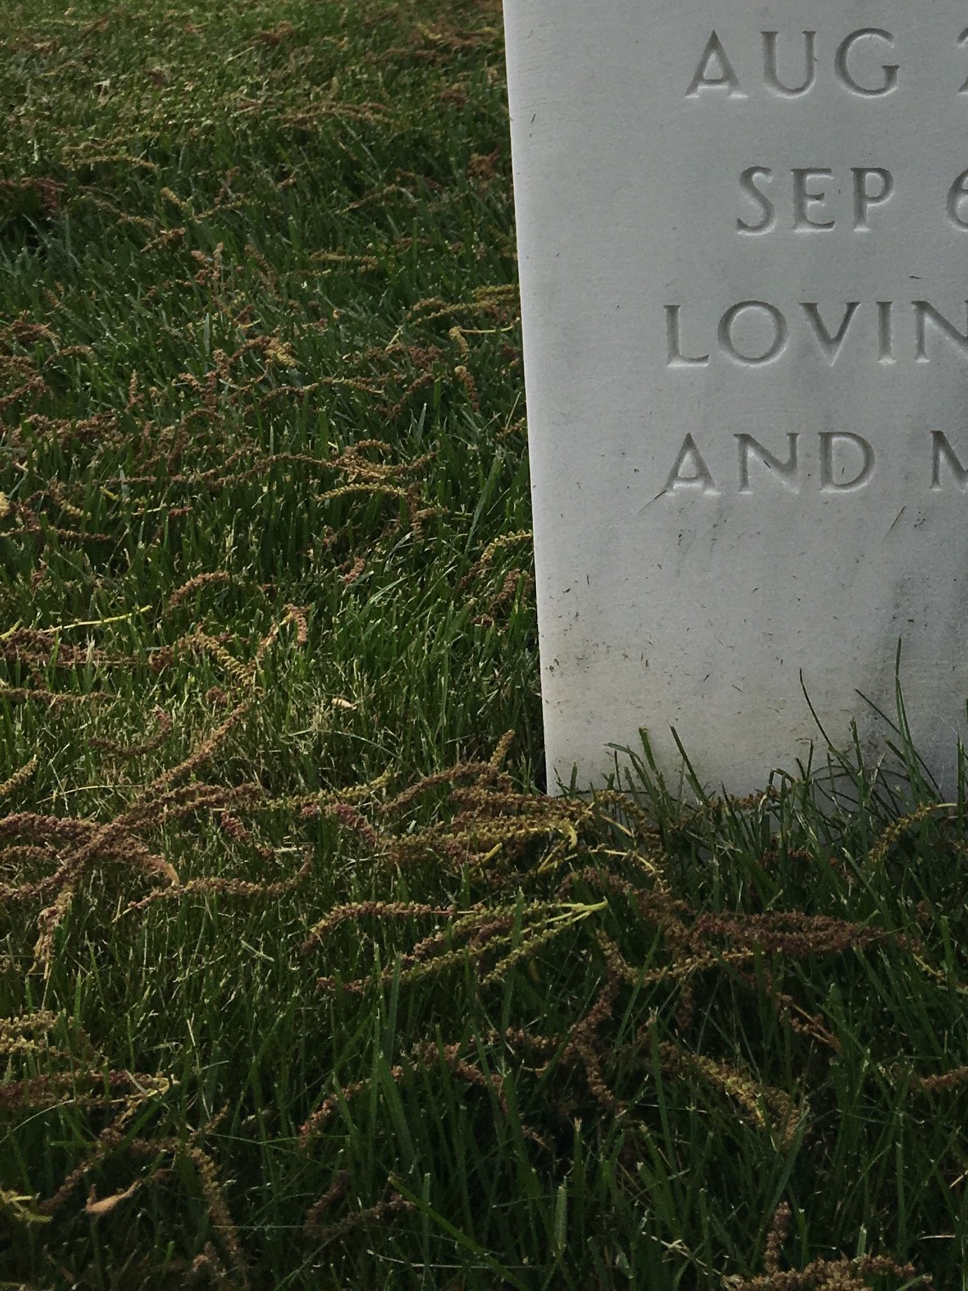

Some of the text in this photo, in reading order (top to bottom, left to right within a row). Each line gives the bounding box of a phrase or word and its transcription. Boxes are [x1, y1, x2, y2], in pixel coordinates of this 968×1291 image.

[684, 27, 901, 99] AUG
[736, 165, 894, 236] SEP
[664, 430, 876, 495] AND
